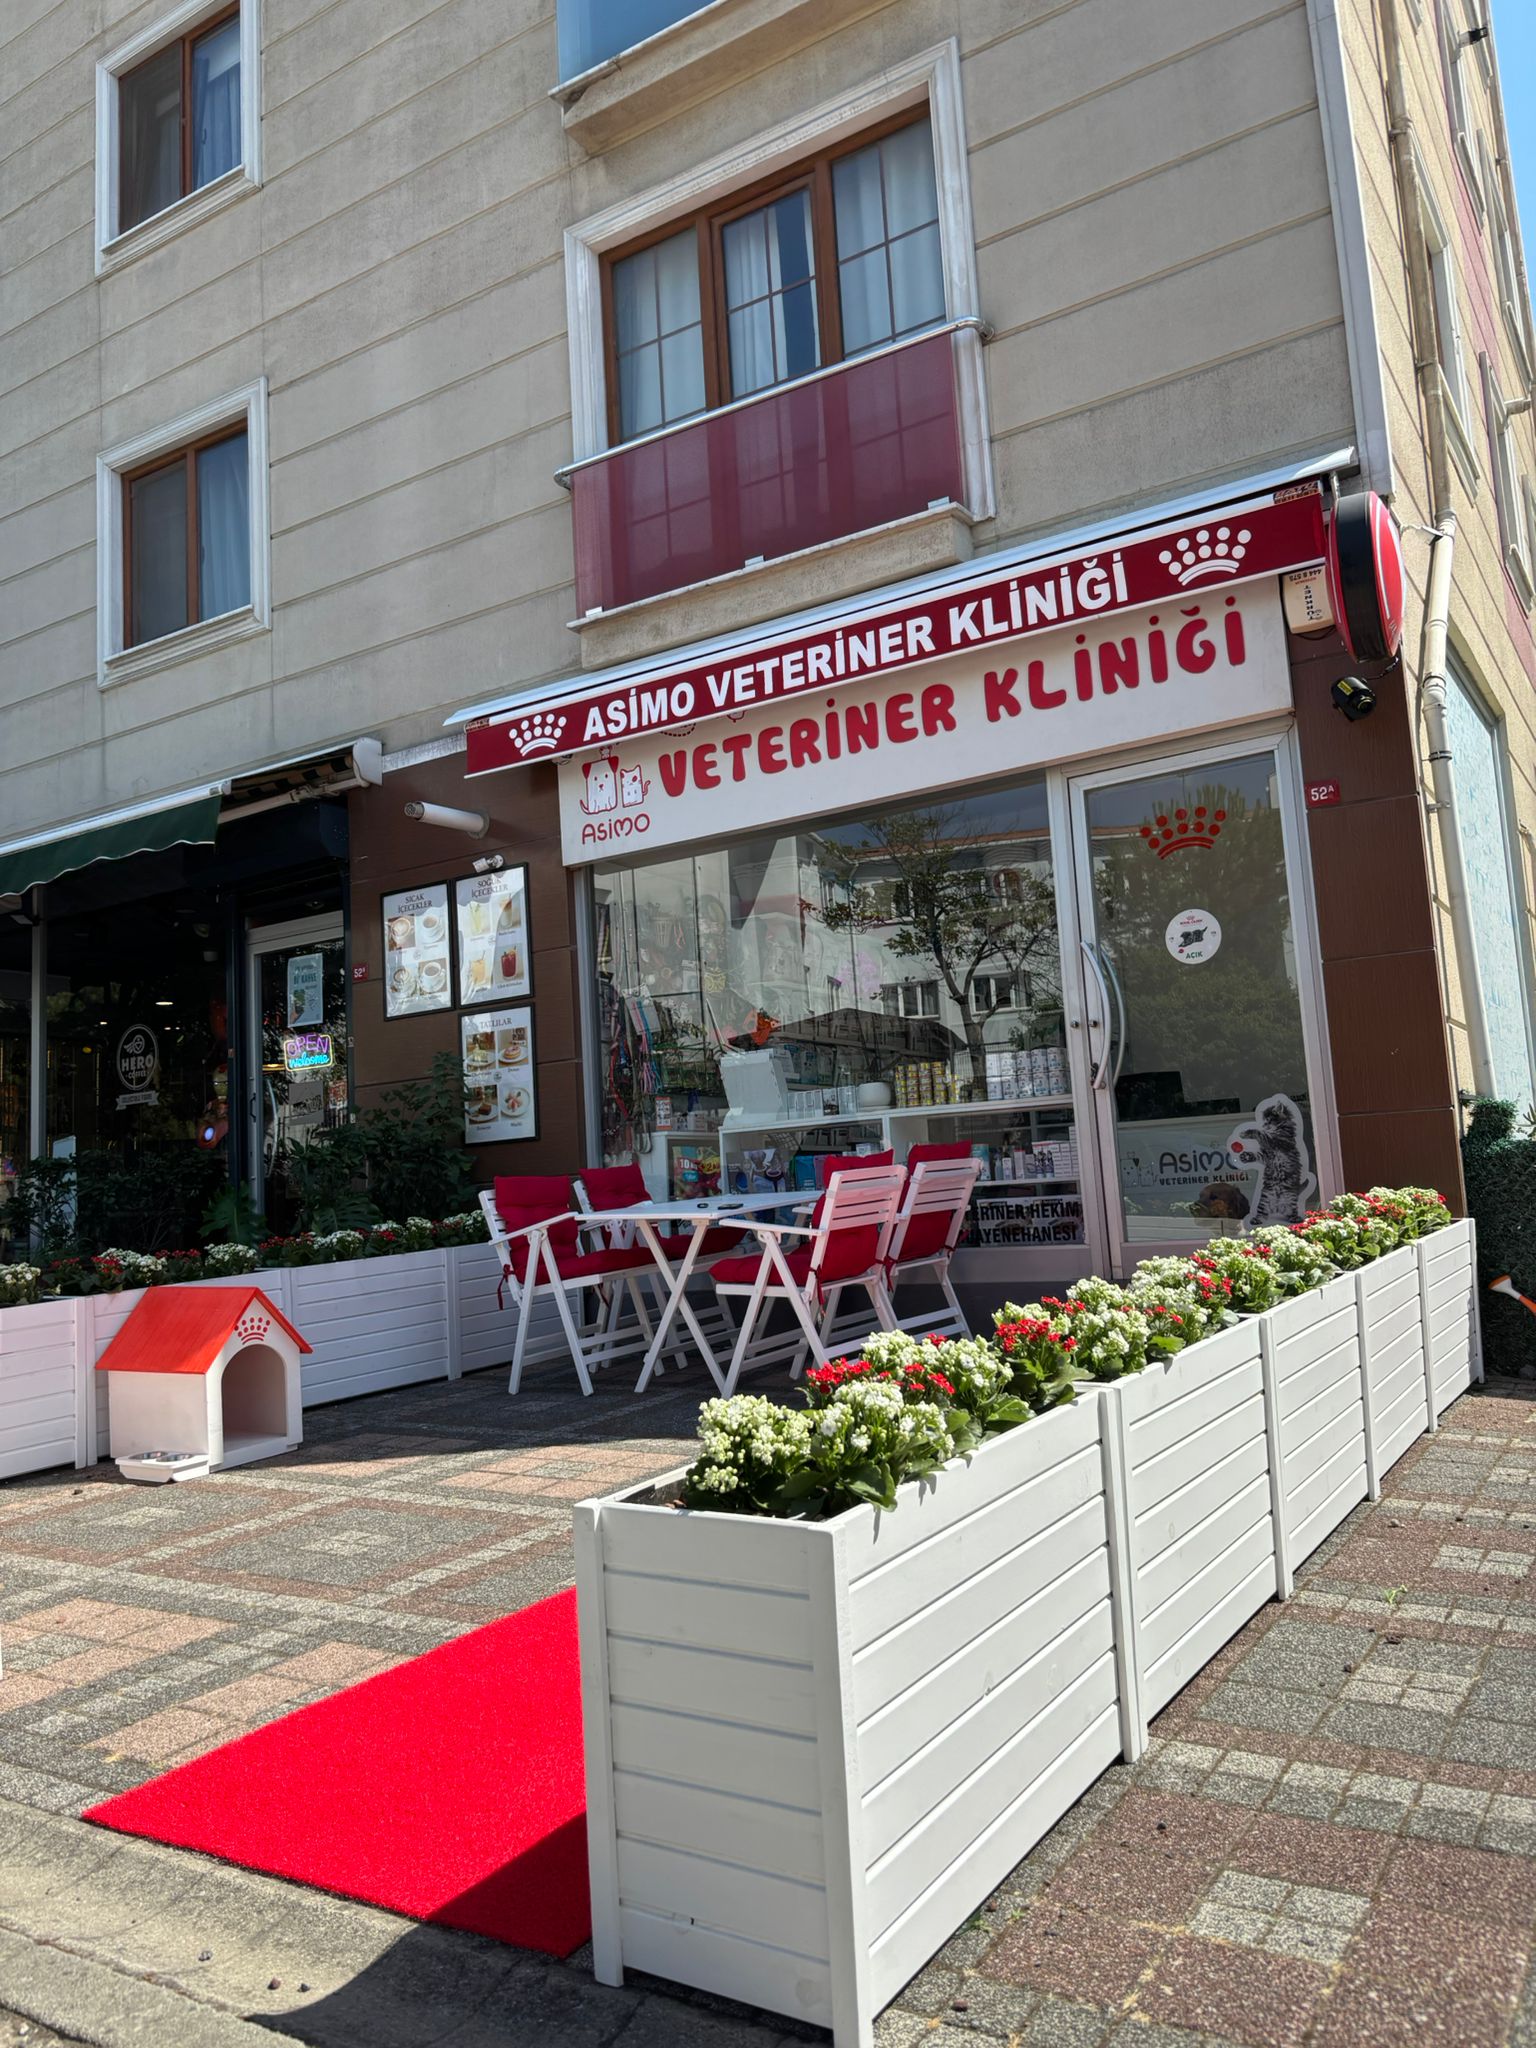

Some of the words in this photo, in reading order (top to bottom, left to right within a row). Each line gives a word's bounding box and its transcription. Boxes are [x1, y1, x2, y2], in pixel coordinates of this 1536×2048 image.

[583, 683, 695, 743] ASİMO
[705, 615, 936, 709] VETERİNER
[948, 552, 1129, 647] KLİNİĞİ
[658, 683, 957, 798] VETERİNER
[983, 595, 1246, 723] KLİNİĞİ
[1185, 950, 1203, 960] AÇIK
[286, 1033, 330, 1057] OPEN
[121, 1054, 154, 1072] HERO
[289, 1051, 330, 1069] welcome
[1159, 1174, 1209, 1187] VETERİNER
[1213, 1172, 1249, 1184] KLİNİĞİ
[1031, 1198, 1079, 1219] HEKİM
